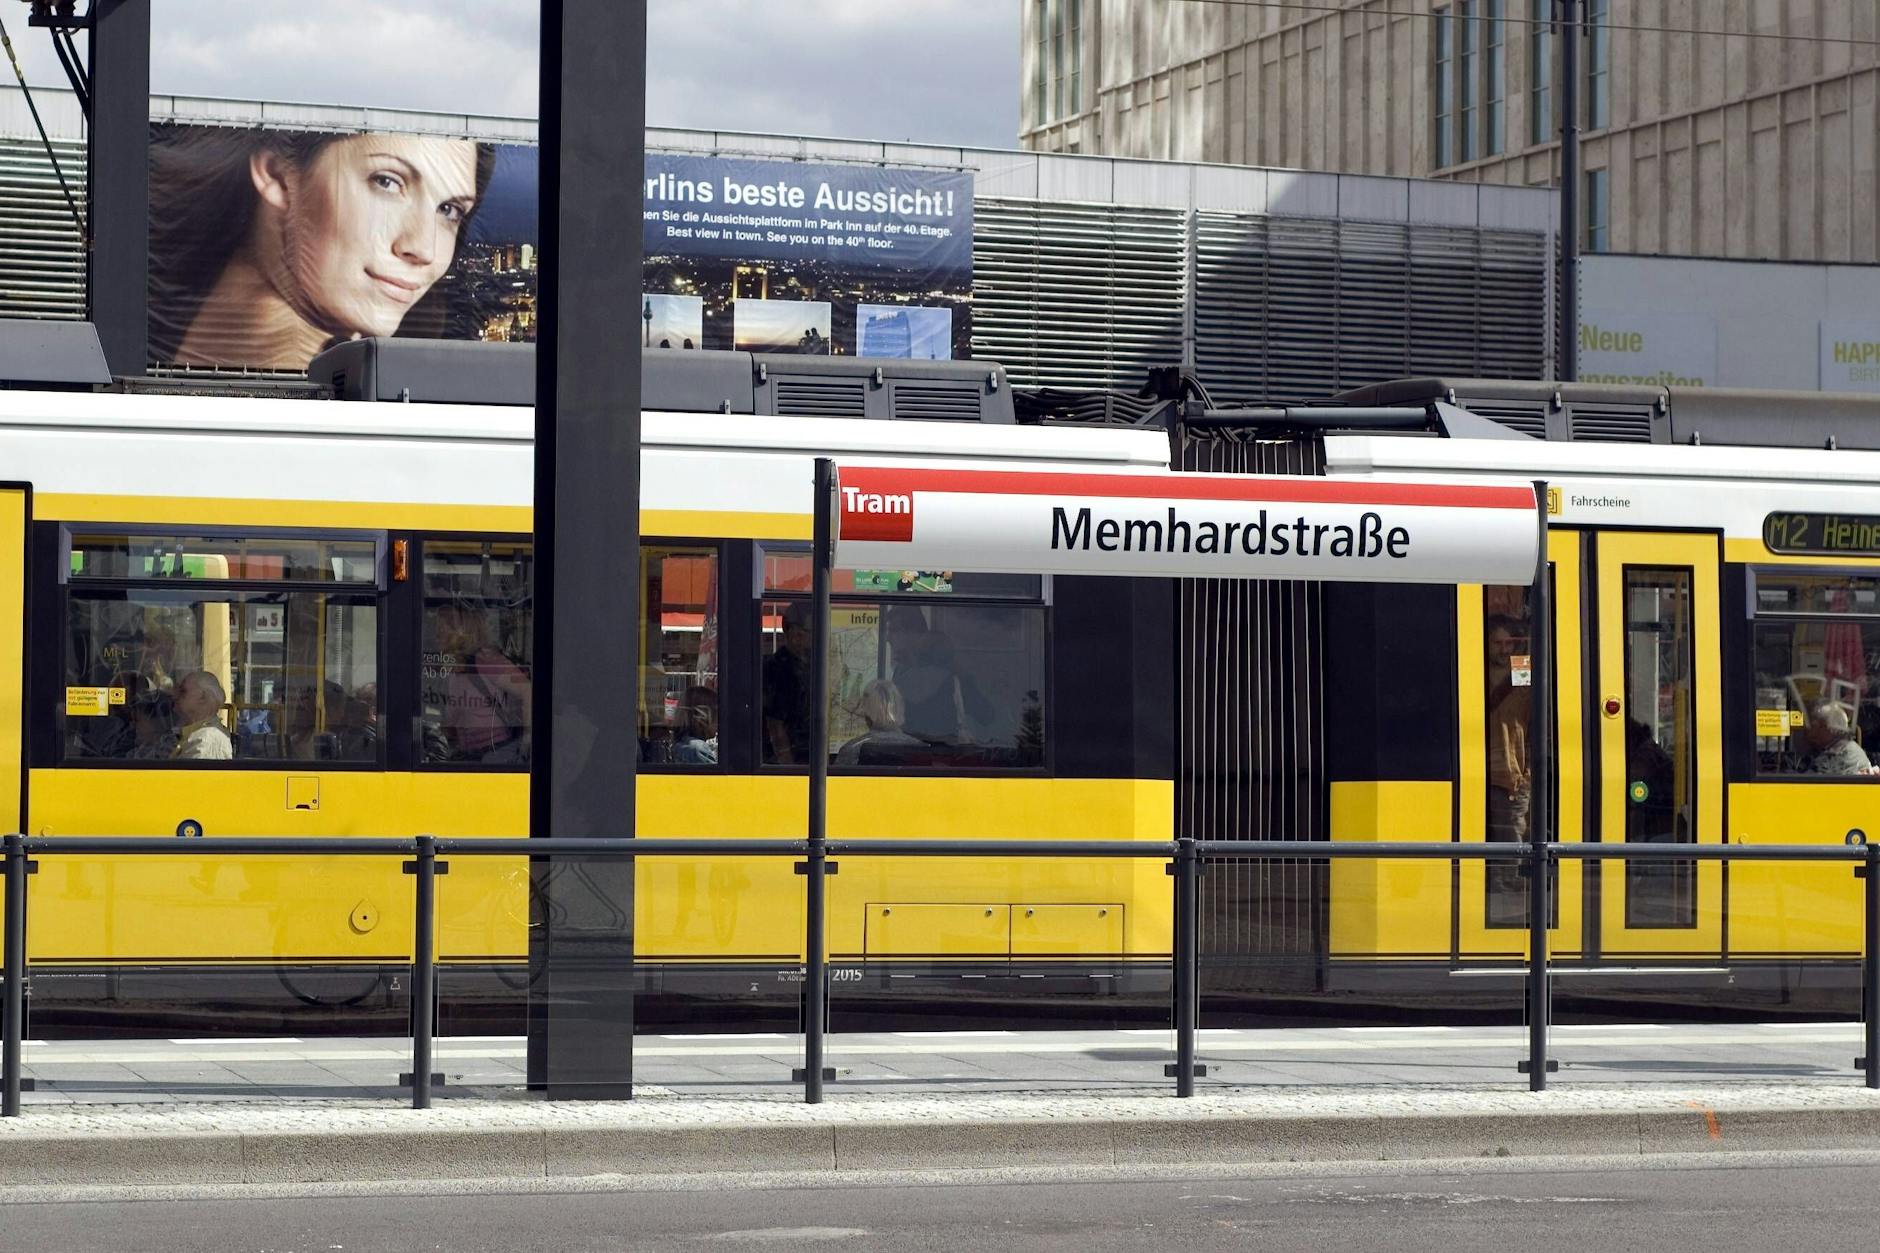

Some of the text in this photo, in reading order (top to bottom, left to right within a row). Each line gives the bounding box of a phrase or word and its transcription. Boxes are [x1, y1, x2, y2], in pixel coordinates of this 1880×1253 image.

[644, 172, 954, 217] rlins beste Aussicht!
[662, 210, 680, 222] Sie
[682, 211, 700, 223] die
[702, 212, 802, 228] Aussichtsplattform
[804, 218, 818, 229] im
[820, 219, 843, 231] Park
[845, 220, 862, 232] Inn
[864, 222, 882, 233] auf
[883, 223, 901, 234] der
[903, 224, 919, 235] 40.
[920, 225, 953, 239] Etage.
[666, 226, 693, 238] Best
[695, 228, 720, 240] view
[722, 229, 733, 240] in
[735, 230, 764, 241] town.
[766, 231, 787, 243] See
[789, 233, 809, 246] you
[811, 236, 825, 245] on
[827, 235, 844, 246] the
[867, 237, 894, 249] floor.
[1582, 324, 1643, 353] Neue
[841, 486, 911, 514] Tram
[1571, 495, 1631, 508] Fahrscheine
[1051, 507, 1410, 559] Memhardstraße
[1769, 514, 1880, 549] M2 Heine
[832, 969, 863, 982] 2015
